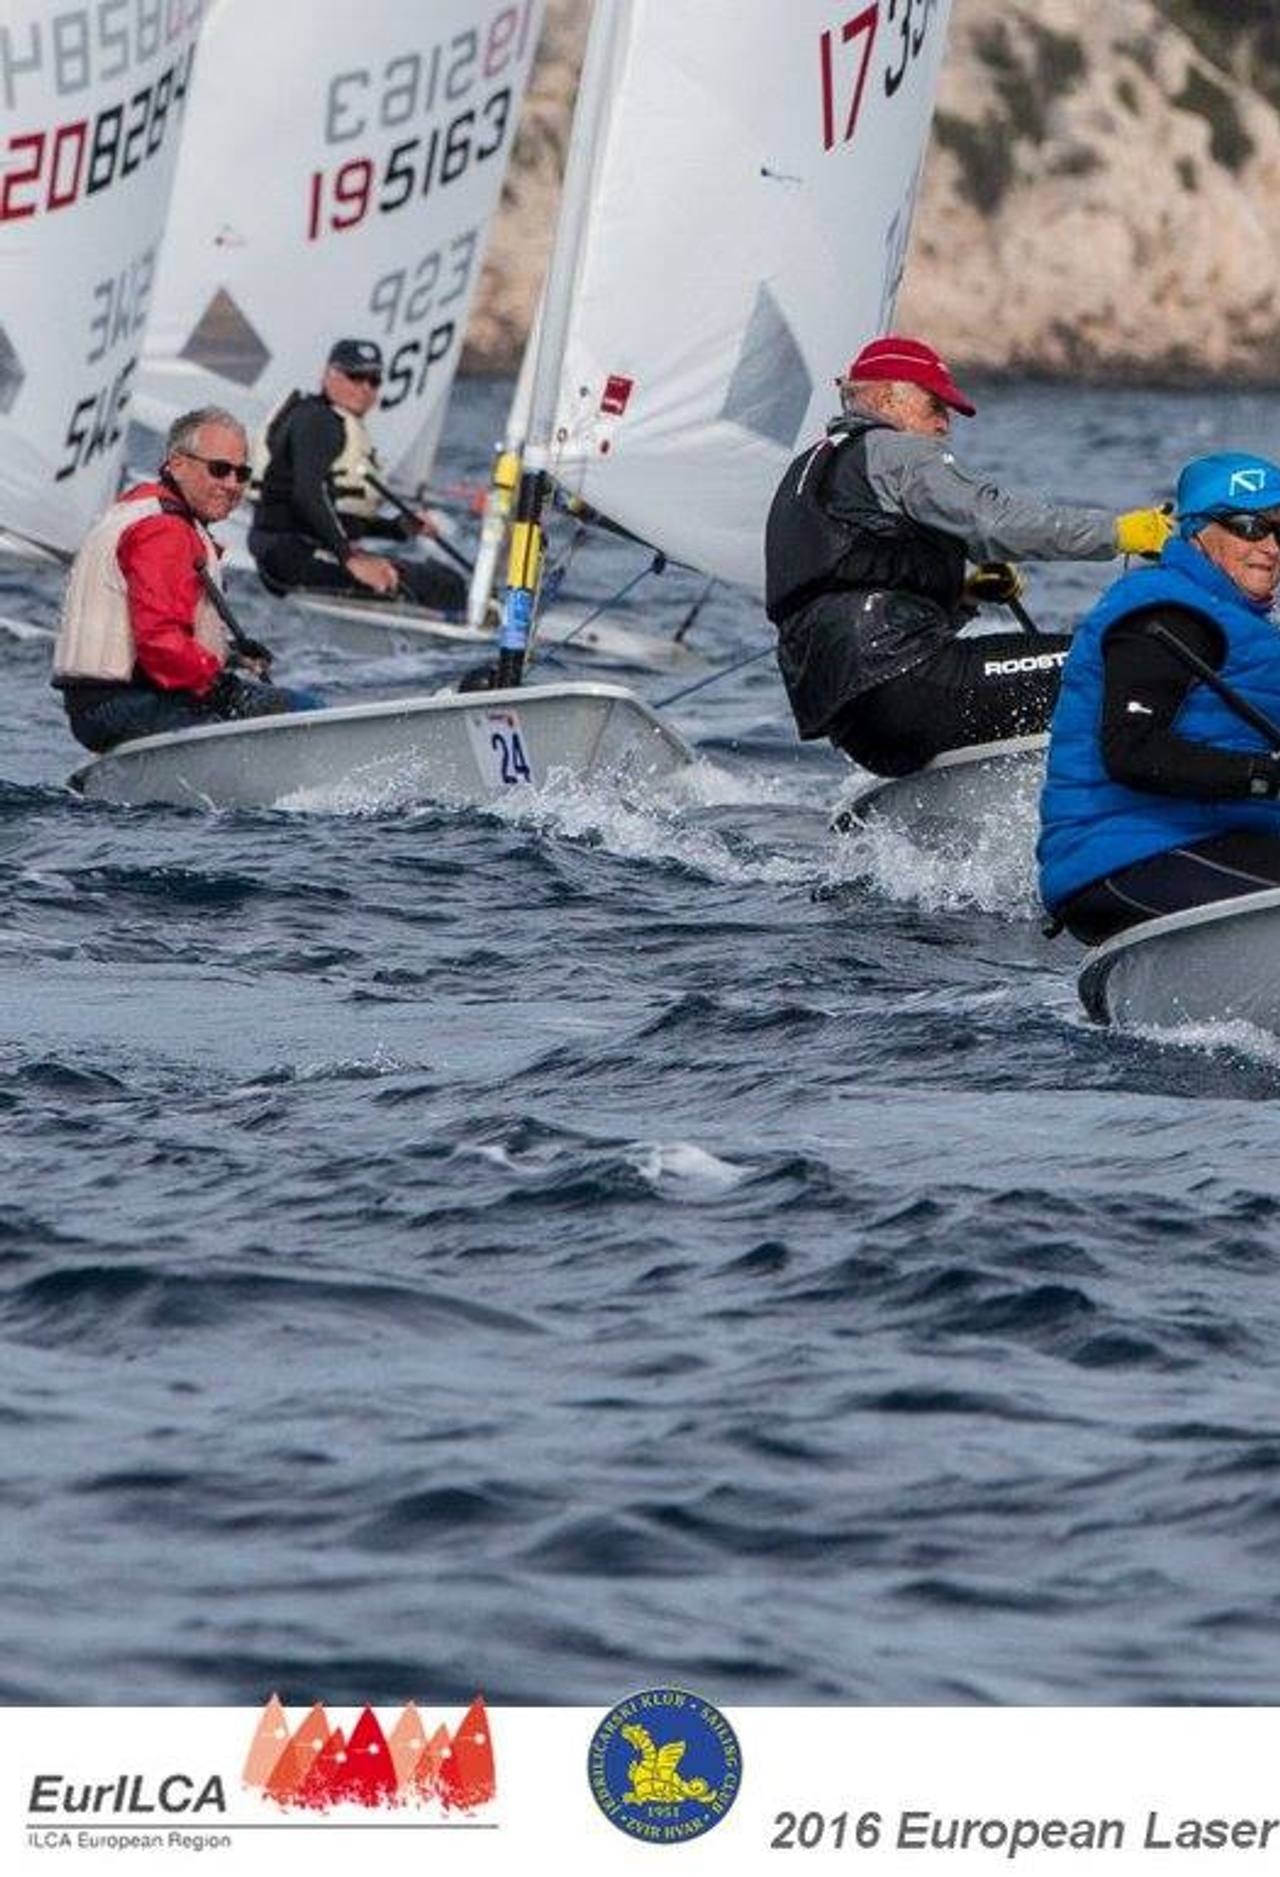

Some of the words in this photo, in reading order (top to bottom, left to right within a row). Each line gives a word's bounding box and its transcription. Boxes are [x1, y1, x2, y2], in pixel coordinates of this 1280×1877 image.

[309, 86, 511, 241] 195163
[380, 320, 455, 411] SP
[984, 650, 1071, 676] ROOST
[492, 733, 532, 784] 24
